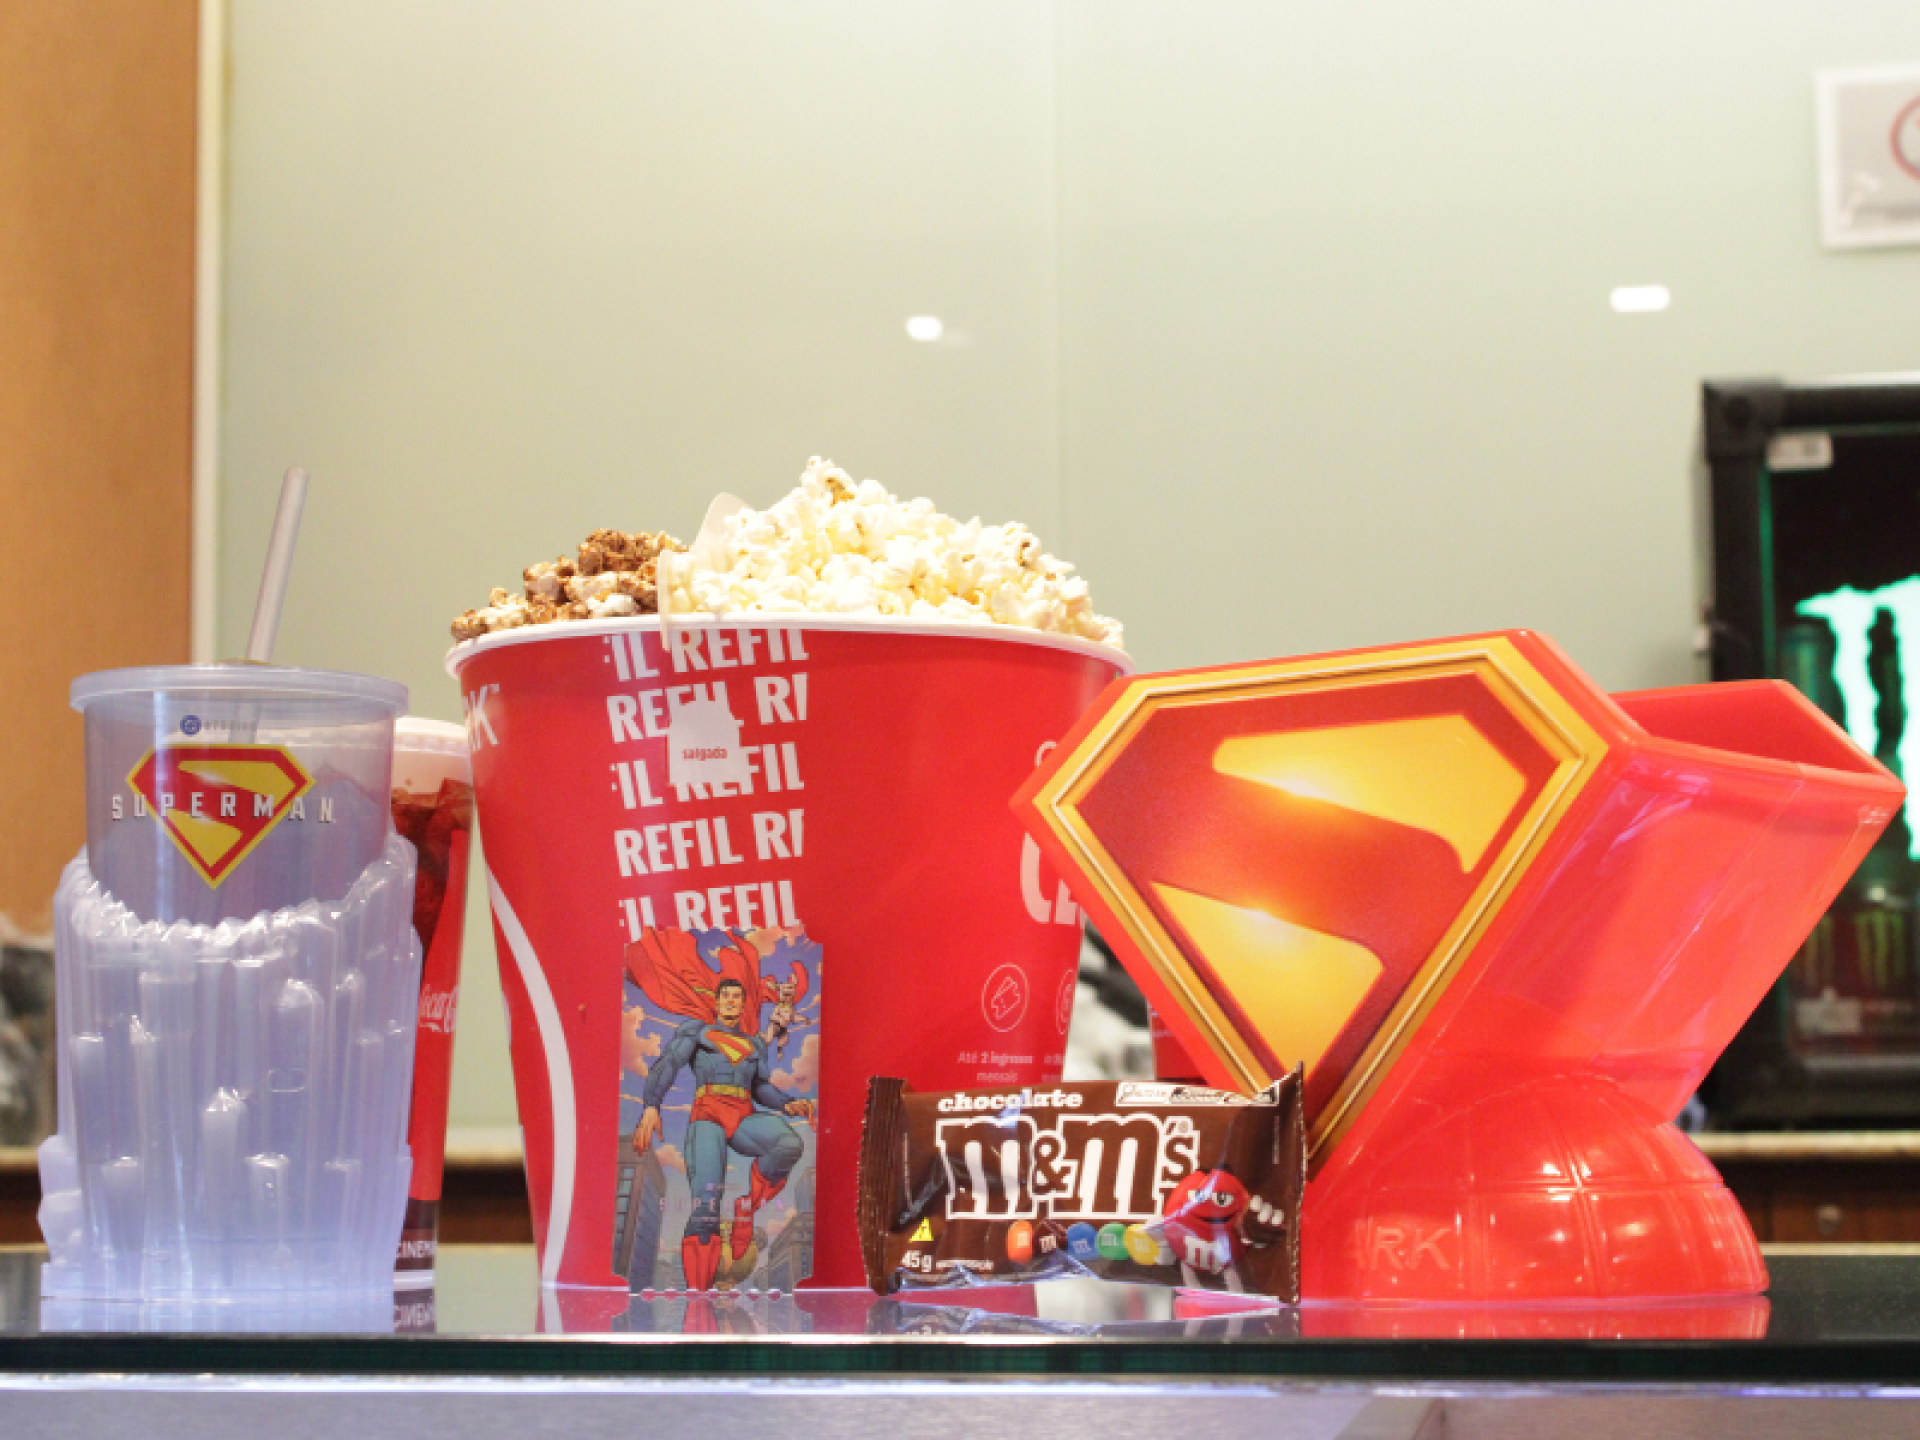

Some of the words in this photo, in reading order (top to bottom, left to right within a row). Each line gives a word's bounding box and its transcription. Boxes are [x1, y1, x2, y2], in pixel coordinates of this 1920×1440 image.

[602, 634, 660, 682] IL
[672, 629, 809, 673] REFIL
[682, 747, 728, 762] salgada
[111, 792, 334, 824] SUPERMAN
[611, 760, 664, 810] IL
[614, 816, 744, 879] REFIL
[673, 879, 804, 933] REFIL
[937, 1088, 1083, 1112] chocolate
